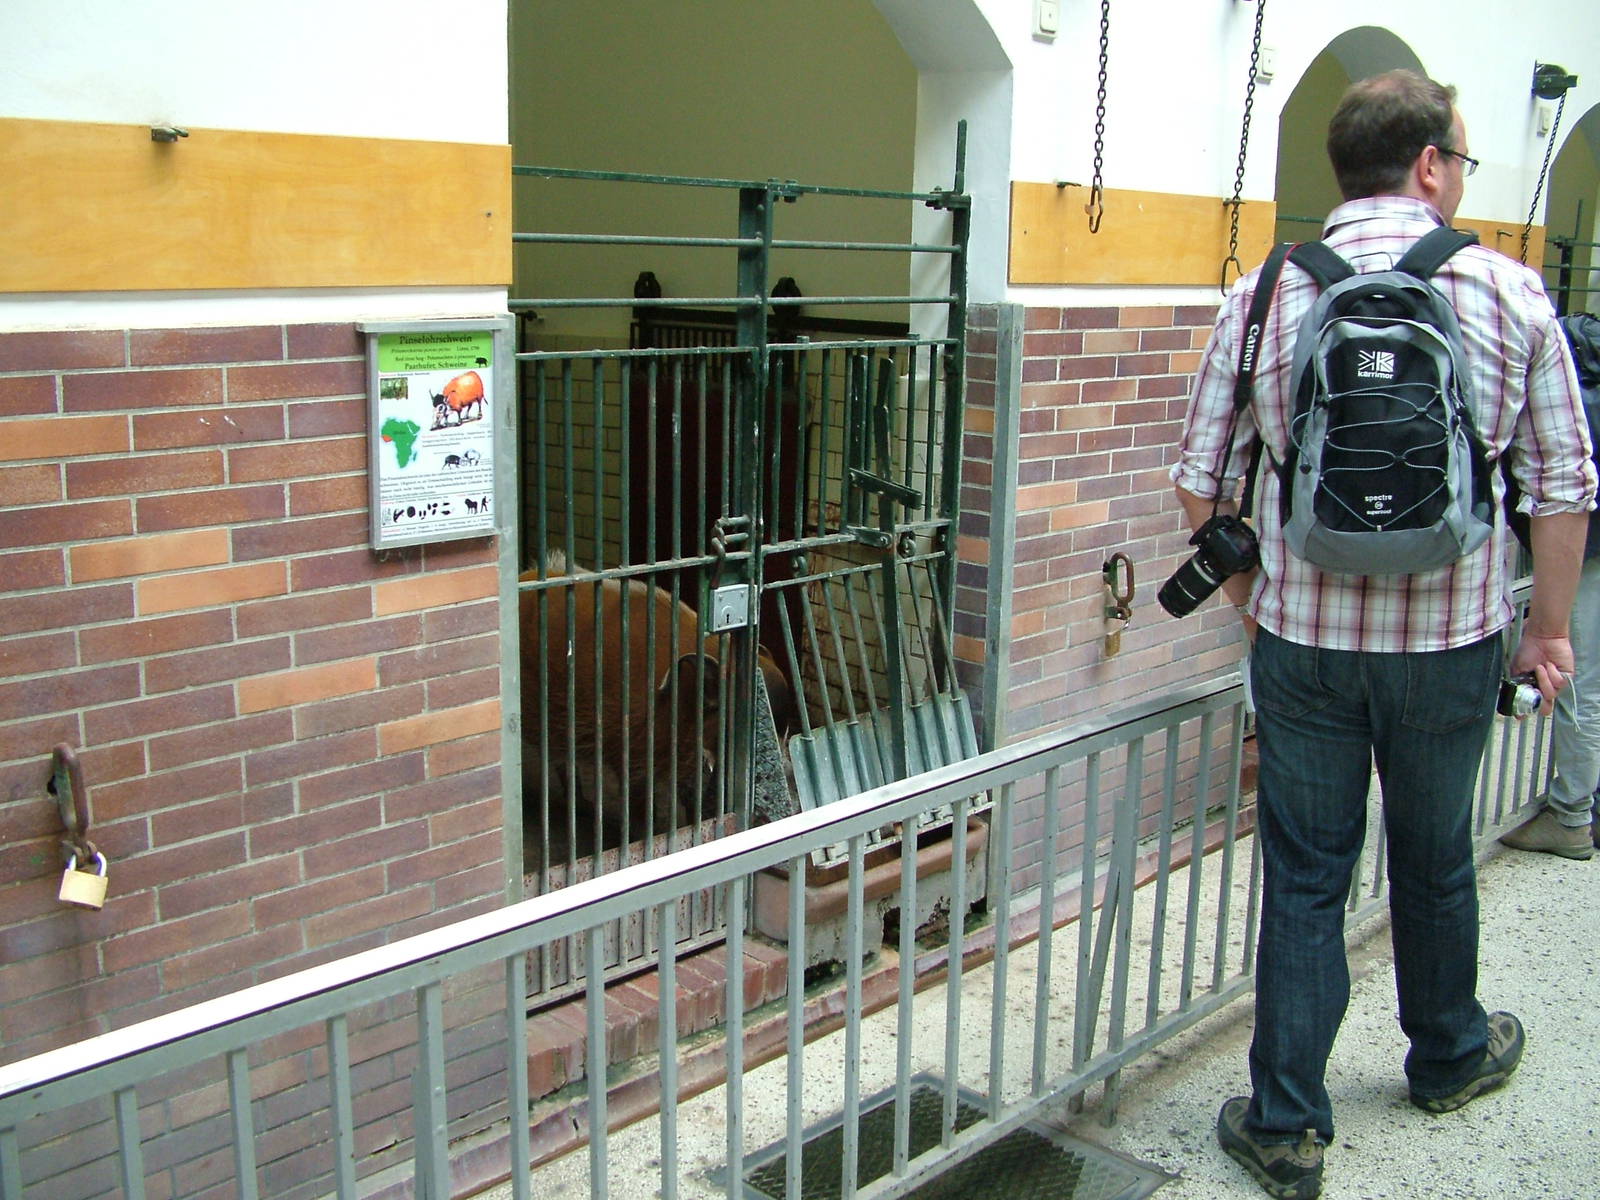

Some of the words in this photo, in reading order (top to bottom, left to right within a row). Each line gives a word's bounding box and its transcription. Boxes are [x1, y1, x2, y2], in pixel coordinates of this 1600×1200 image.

[399, 334, 472, 344] Pinselohrschwein
[1242, 324, 1260, 371] Canon
[1357, 370, 1394, 379] karrimor
[1365, 494, 1392, 502] spectre
